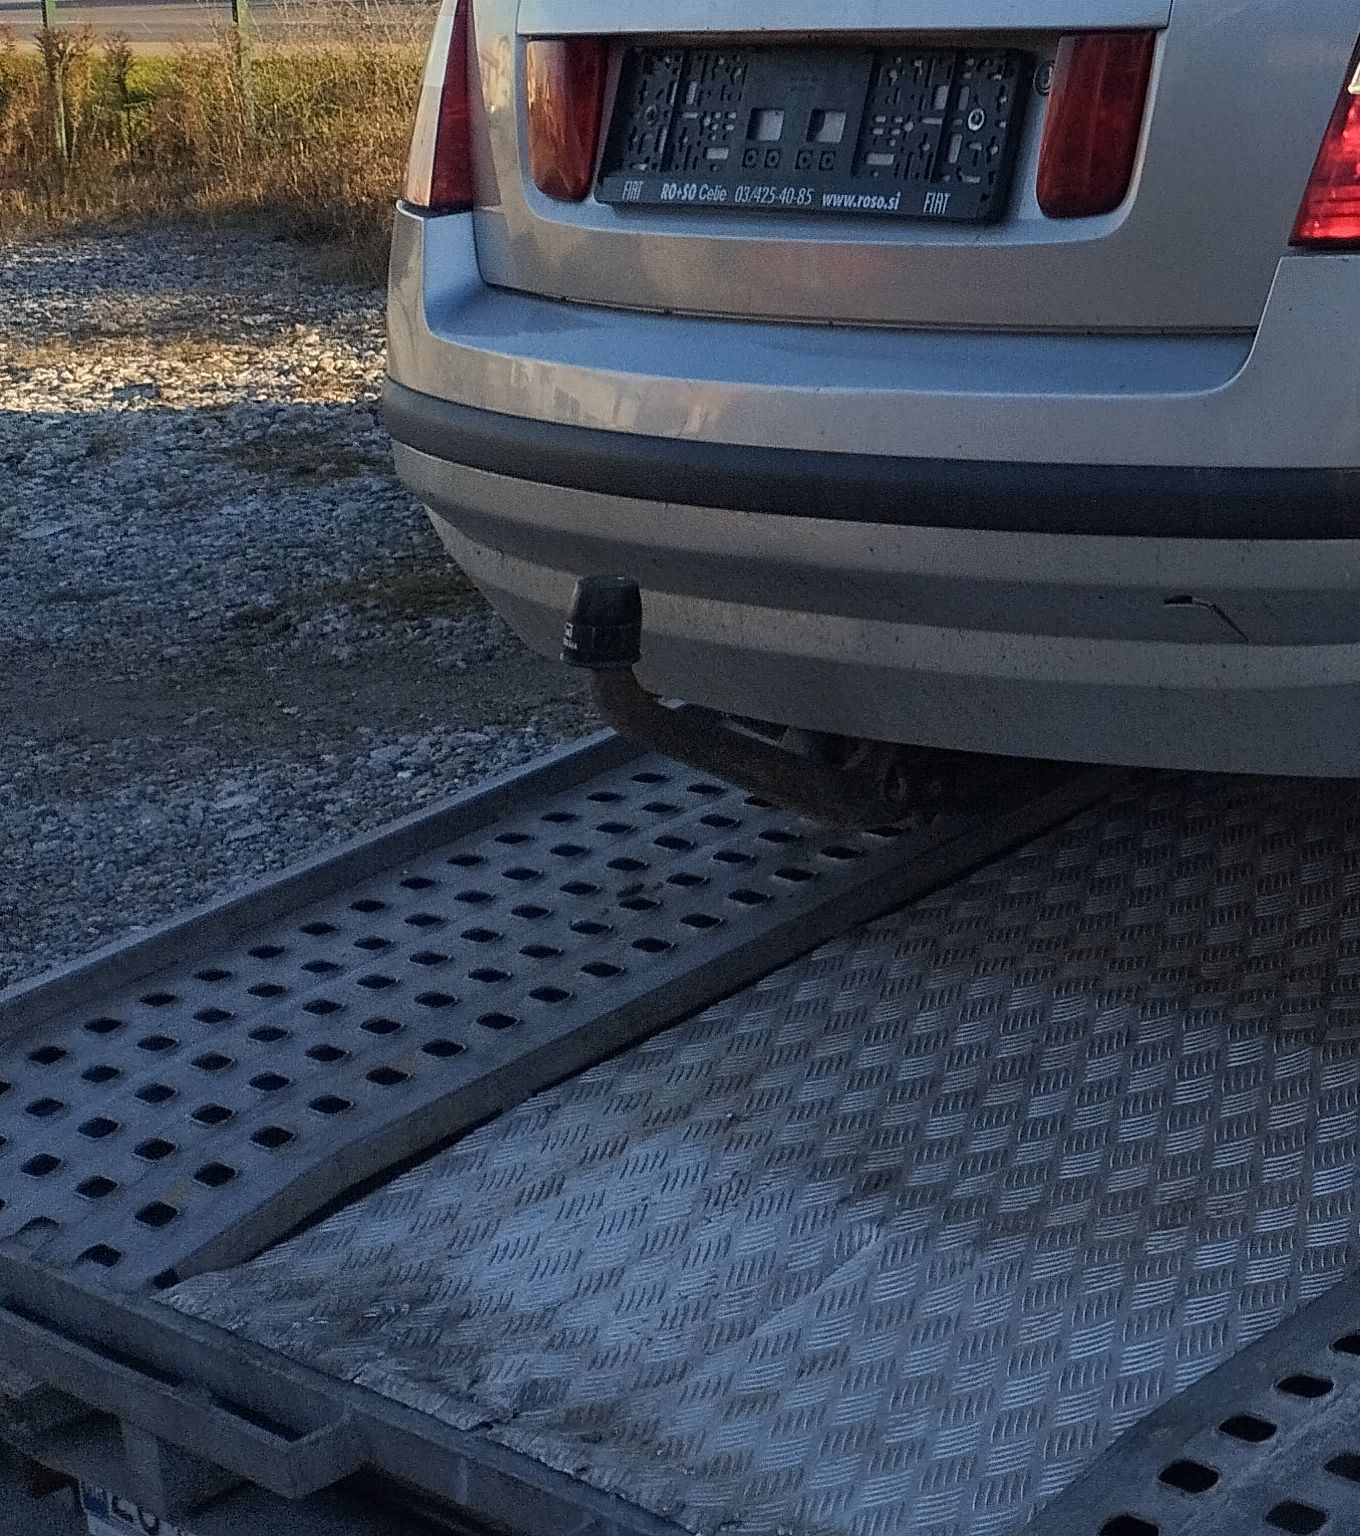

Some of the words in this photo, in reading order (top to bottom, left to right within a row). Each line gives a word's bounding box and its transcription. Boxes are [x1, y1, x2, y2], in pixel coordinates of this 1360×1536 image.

[622, 180, 644, 201] FIAT
[734, 185, 814, 206] 03/425-40-85
[822, 191, 901, 212] www.roso.si
[923, 191, 951, 215] FIAT
